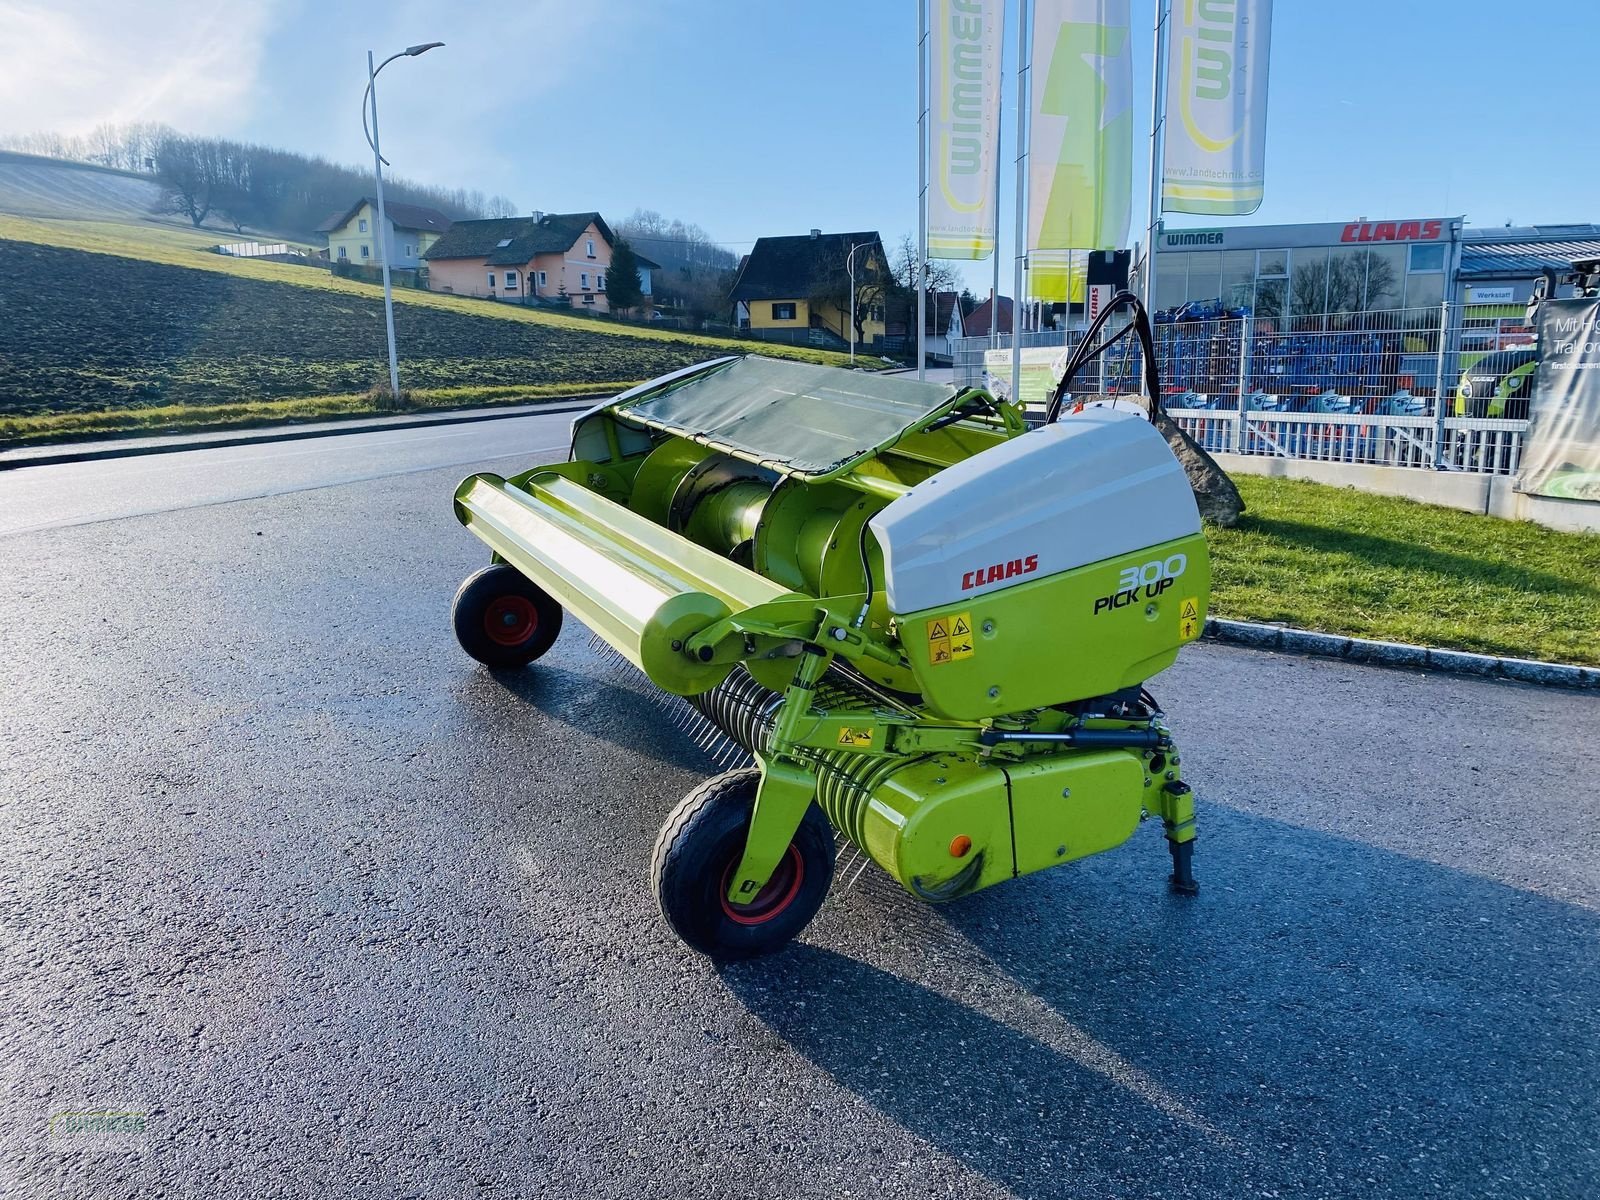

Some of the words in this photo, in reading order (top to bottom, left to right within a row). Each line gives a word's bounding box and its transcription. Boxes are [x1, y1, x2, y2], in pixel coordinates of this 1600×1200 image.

[1167, 232, 1224, 246] WIMMER
[1341, 221, 1442, 242] CLAAS
[1555, 317, 1578, 332] Mit
[961, 554, 1039, 591] CLAAS
[1117, 553, 1187, 594] 300
[1093, 586, 1141, 616] PICK
[1145, 576, 1175, 598] UP
